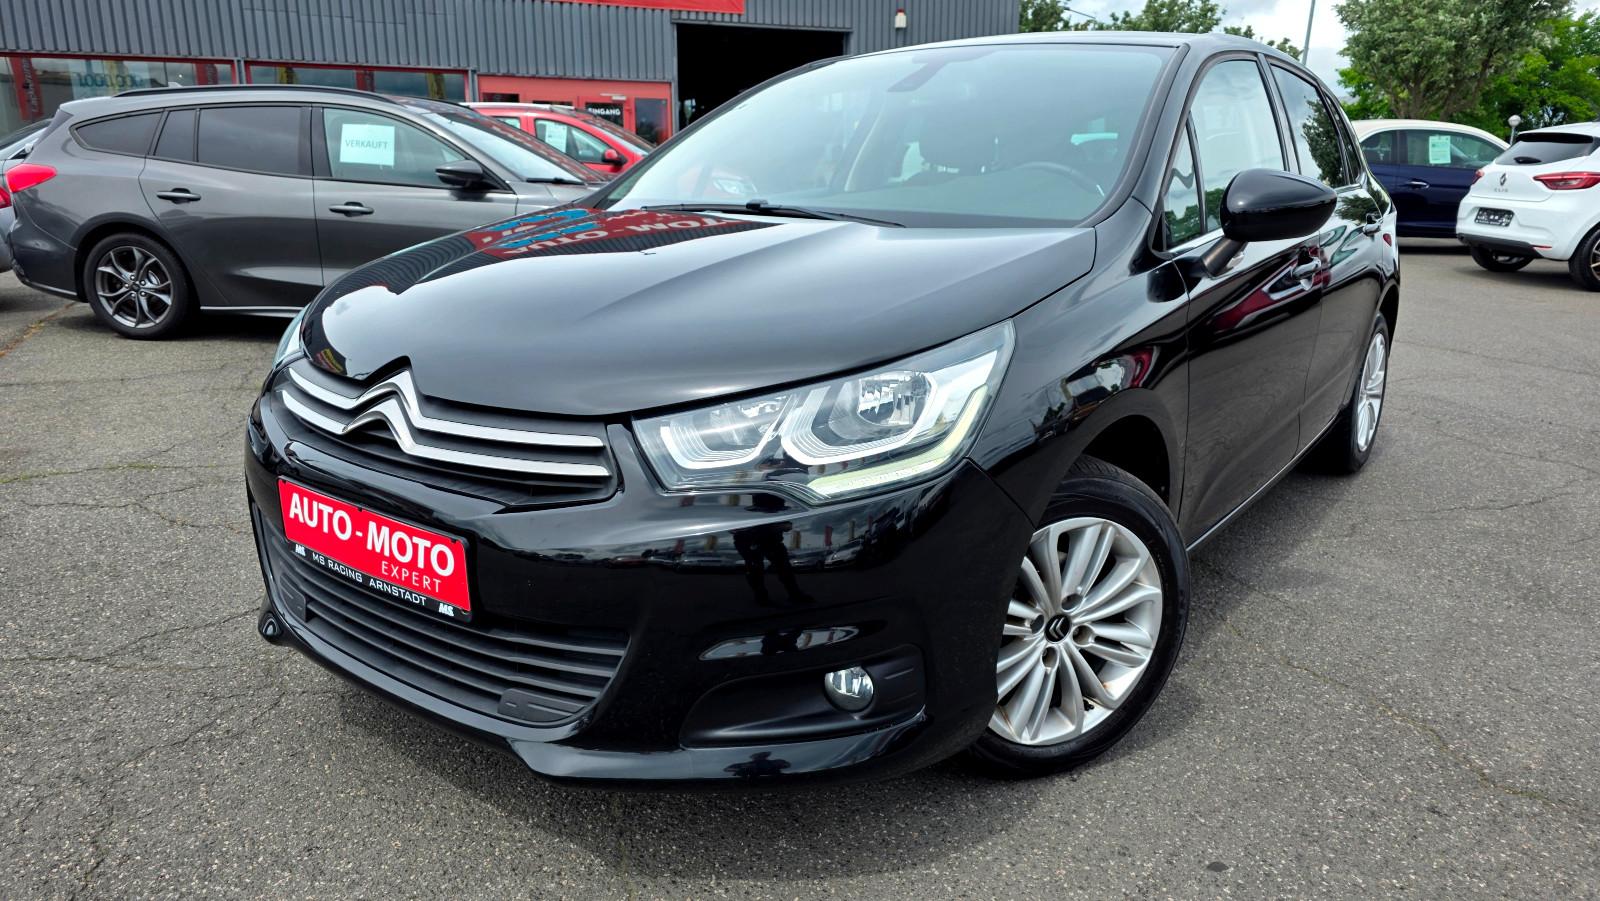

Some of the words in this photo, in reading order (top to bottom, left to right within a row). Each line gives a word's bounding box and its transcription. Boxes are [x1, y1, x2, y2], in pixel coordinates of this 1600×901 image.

[588, 107, 621, 116] EINGANG
[345, 139, 388, 149] VERKAUFT
[312, 553, 325, 566] MS
[327, 560, 363, 583] RACING
[369, 578, 427, 606] ARNSTADT
[381, 561, 442, 593] EXPERT
[438, 603, 454, 617] MS
